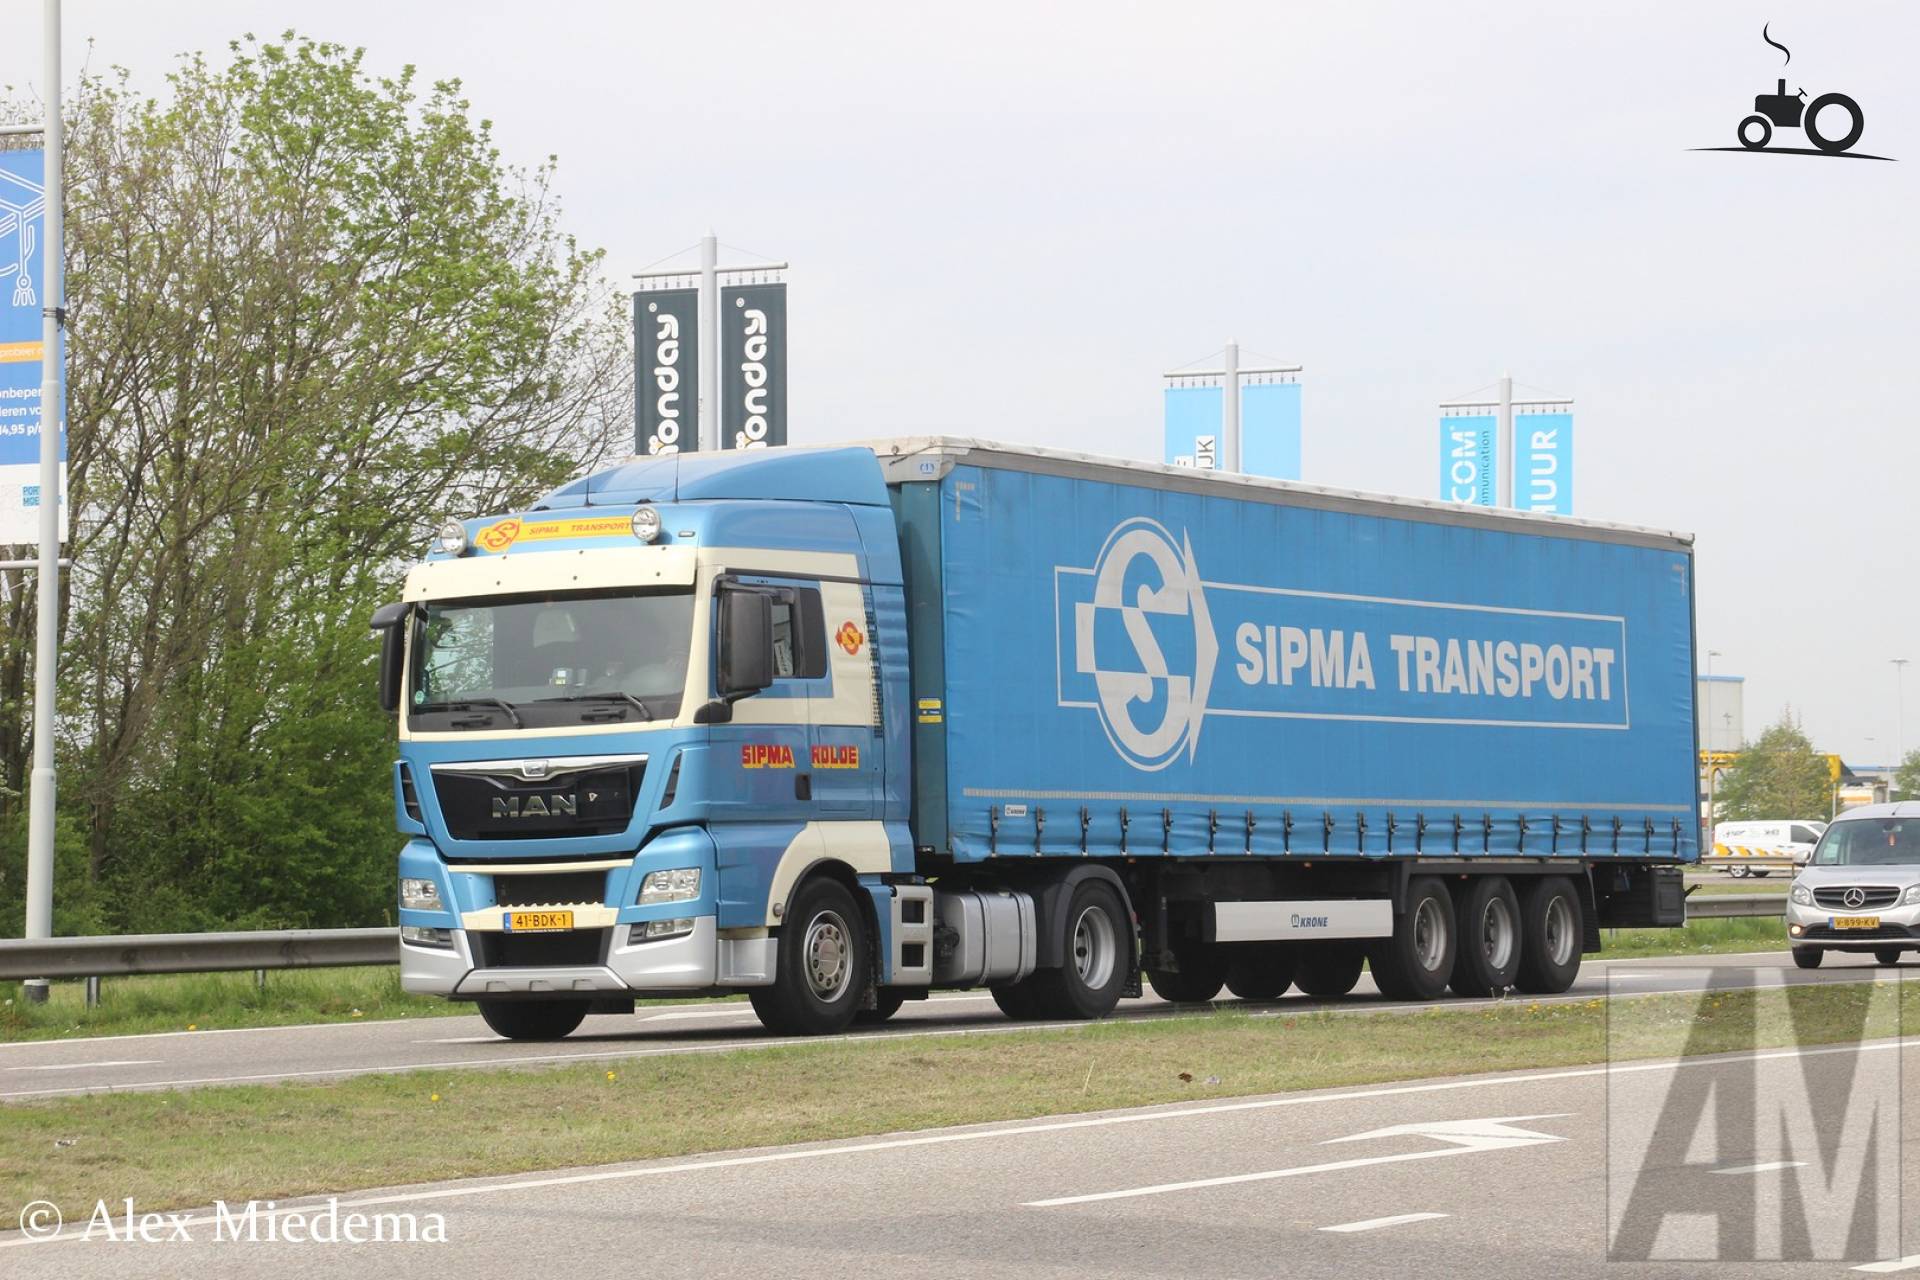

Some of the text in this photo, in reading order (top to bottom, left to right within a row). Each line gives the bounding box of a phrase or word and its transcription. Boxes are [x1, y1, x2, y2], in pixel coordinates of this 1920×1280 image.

[653, 314, 680, 455] onday
[741, 309, 768, 448] onday
[1480, 431, 1489, 506] mmunication
[529, 525, 559, 535] SIPMA
[571, 522, 631, 533] TRANSPORT
[1235, 622, 1376, 690] SIPMA
[1390, 634, 1615, 700] TRANSPORT
[742, 744, 796, 768] SIPMA
[492, 794, 577, 818] MAN
[516, 913, 567, 928] 41-BDK-1
[1300, 916, 1328, 928] KRONE
